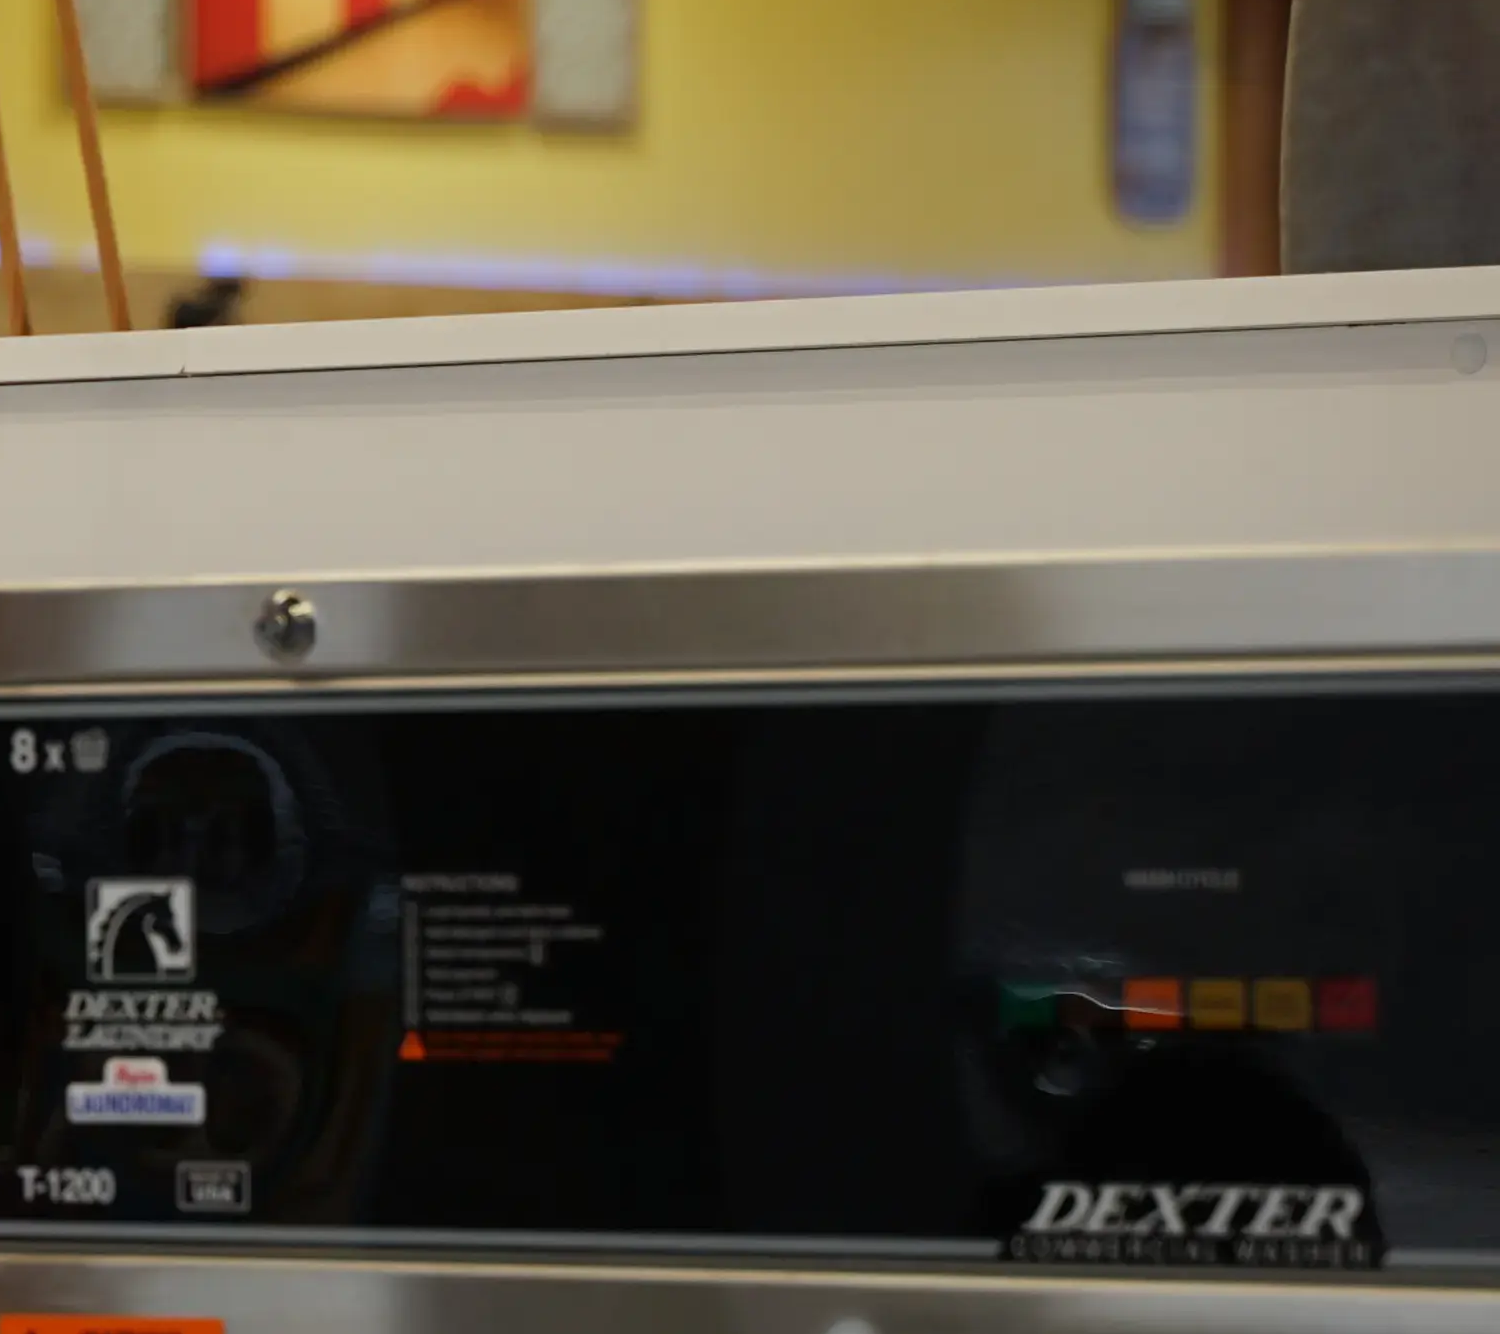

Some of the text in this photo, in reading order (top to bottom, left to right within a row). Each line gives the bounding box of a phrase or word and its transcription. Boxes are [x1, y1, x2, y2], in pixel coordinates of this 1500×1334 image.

[10, 727, 37, 773] 8
[17, 1165, 116, 1205] T-1200
[1022, 1182, 1364, 1239] DEXTER
